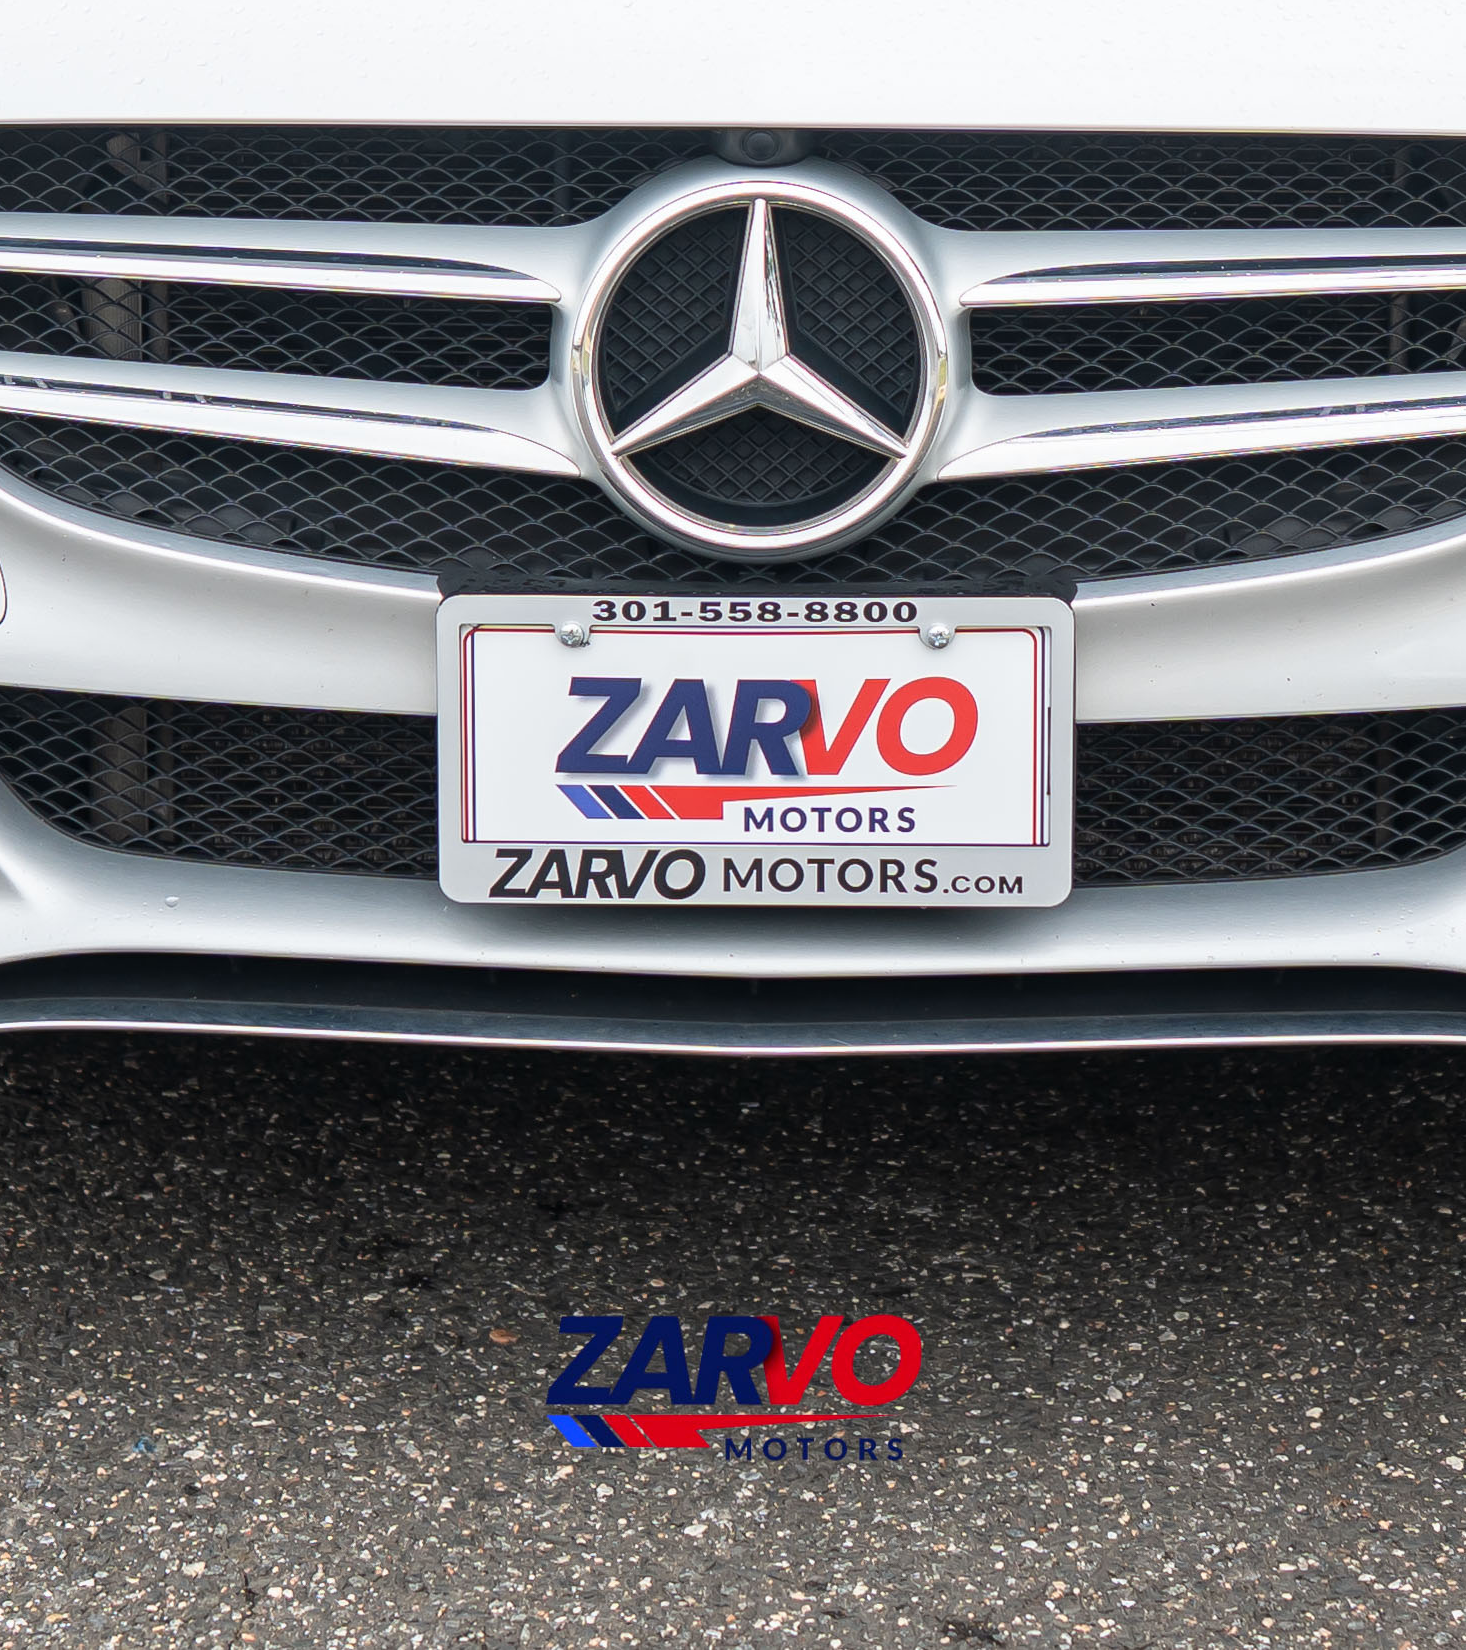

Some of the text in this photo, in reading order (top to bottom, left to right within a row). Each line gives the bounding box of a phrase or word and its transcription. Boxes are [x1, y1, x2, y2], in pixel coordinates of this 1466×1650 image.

[592, 600, 918, 622] 301-558-8800
[555, 676, 979, 776] ZARVO
[743, 806, 916, 834] MOTORS
[489, 849, 707, 900] ZARVO
